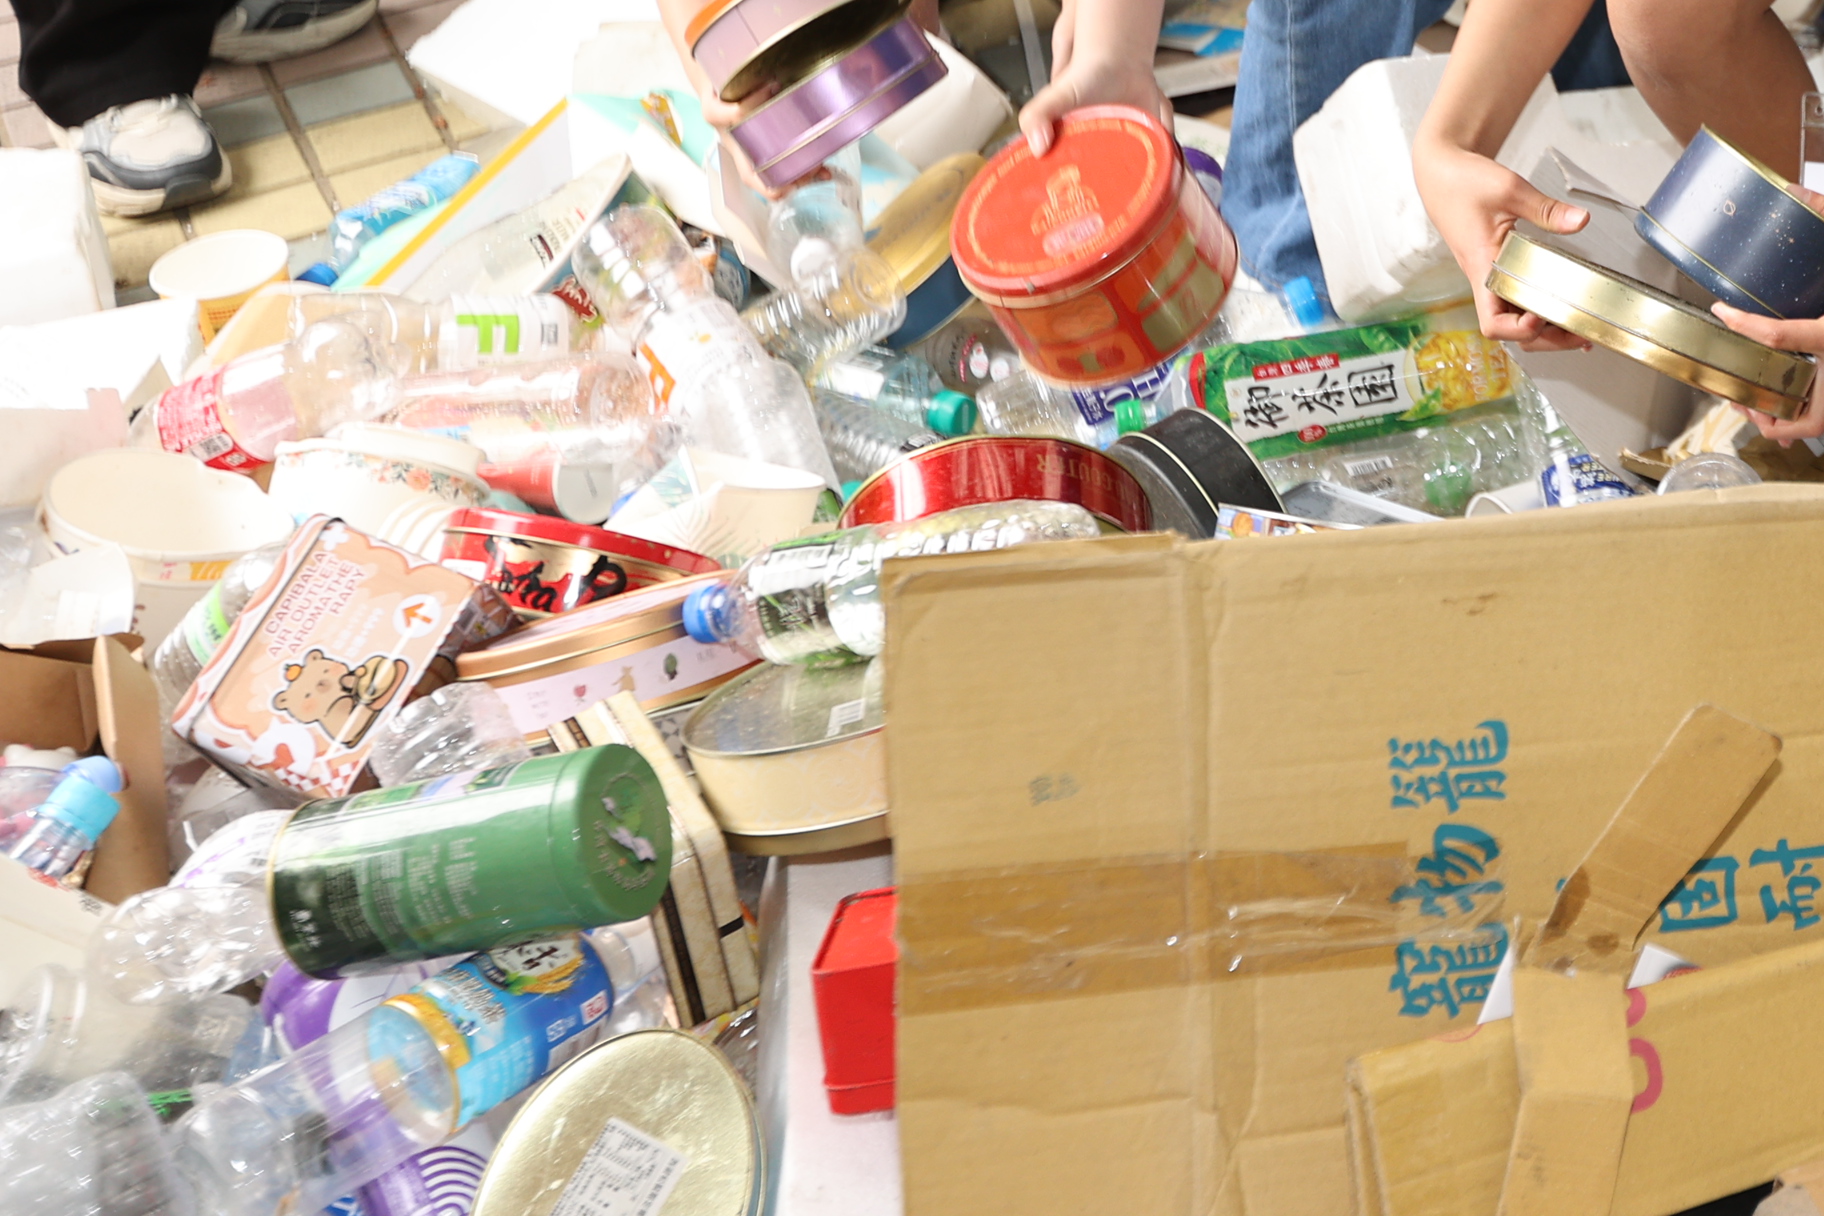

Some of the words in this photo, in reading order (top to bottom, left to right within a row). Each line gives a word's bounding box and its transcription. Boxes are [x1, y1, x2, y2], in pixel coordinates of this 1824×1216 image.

[1244, 362, 1399, 429] 御茶園
[290, 556, 340, 623] OUTLET
[1388, 720, 1509, 1019] 寵物籠
